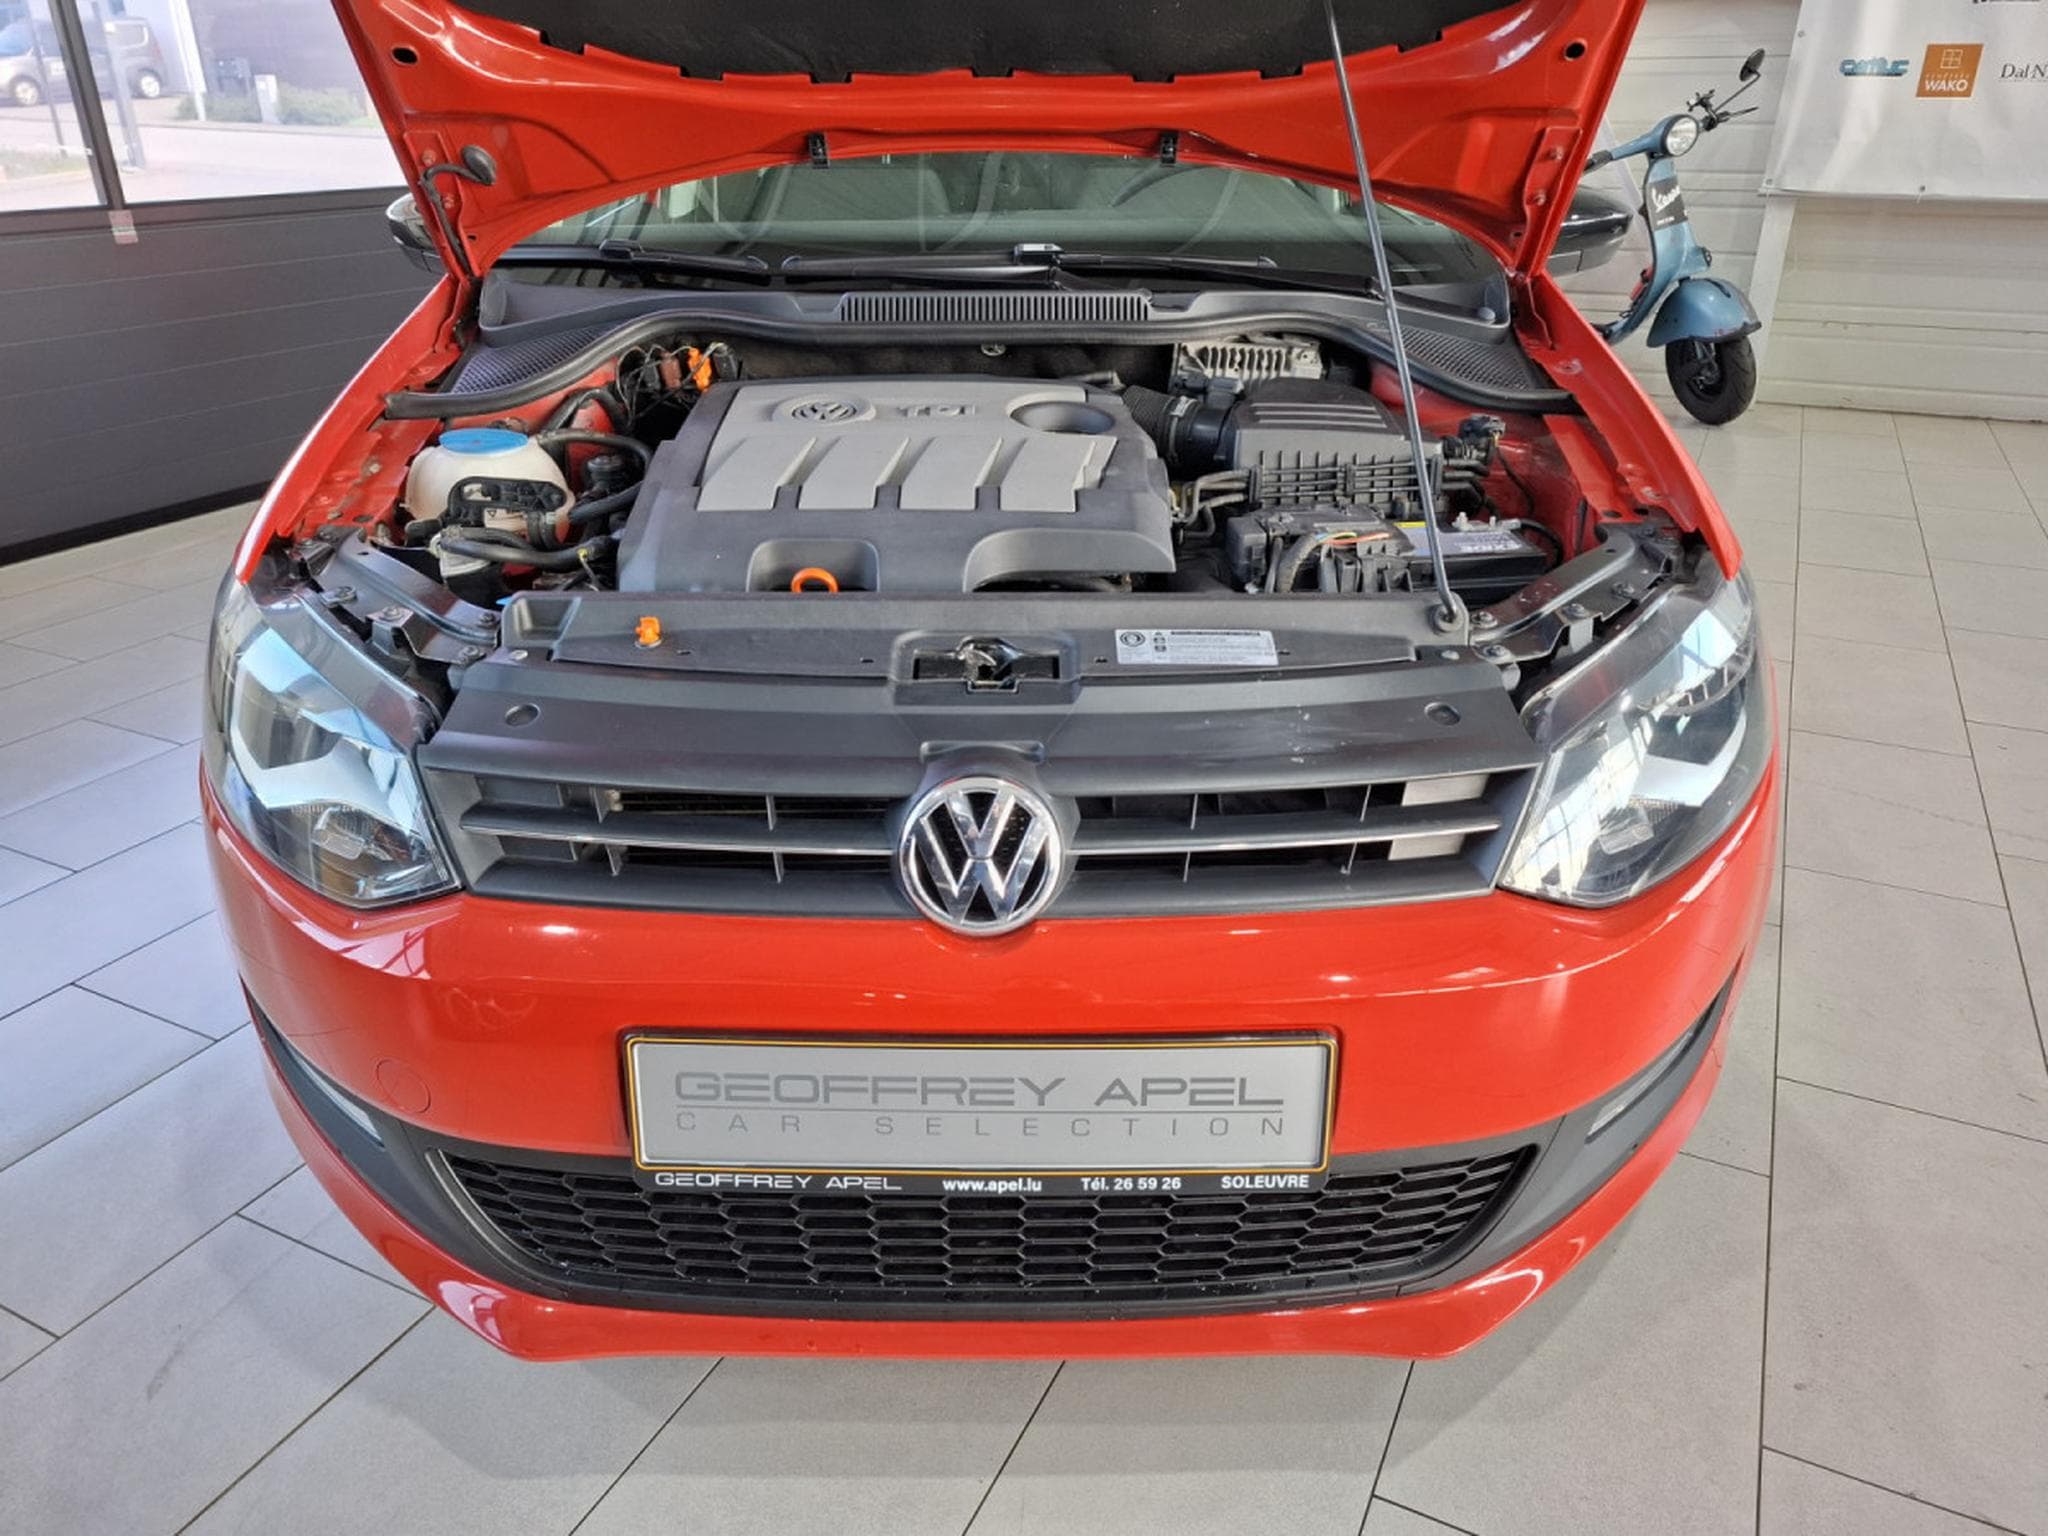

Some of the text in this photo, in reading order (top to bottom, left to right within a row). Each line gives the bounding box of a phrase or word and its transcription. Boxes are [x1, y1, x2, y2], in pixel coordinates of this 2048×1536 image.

[1925, 79, 1969, 92] WAKO
[902, 404, 976, 417] TDI
[675, 1072, 1284, 1107] GEOFFREY APEL
[676, 1112, 1284, 1137] CAR SELECTION
[654, 1172, 902, 1191] GEOFFREY APEL
[942, 1177, 1042, 1194] www.apel.lu
[1081, 1177, 1182, 1191] Tél. 26 59 26
[1221, 1175, 1309, 1189] SOLEUVRE
